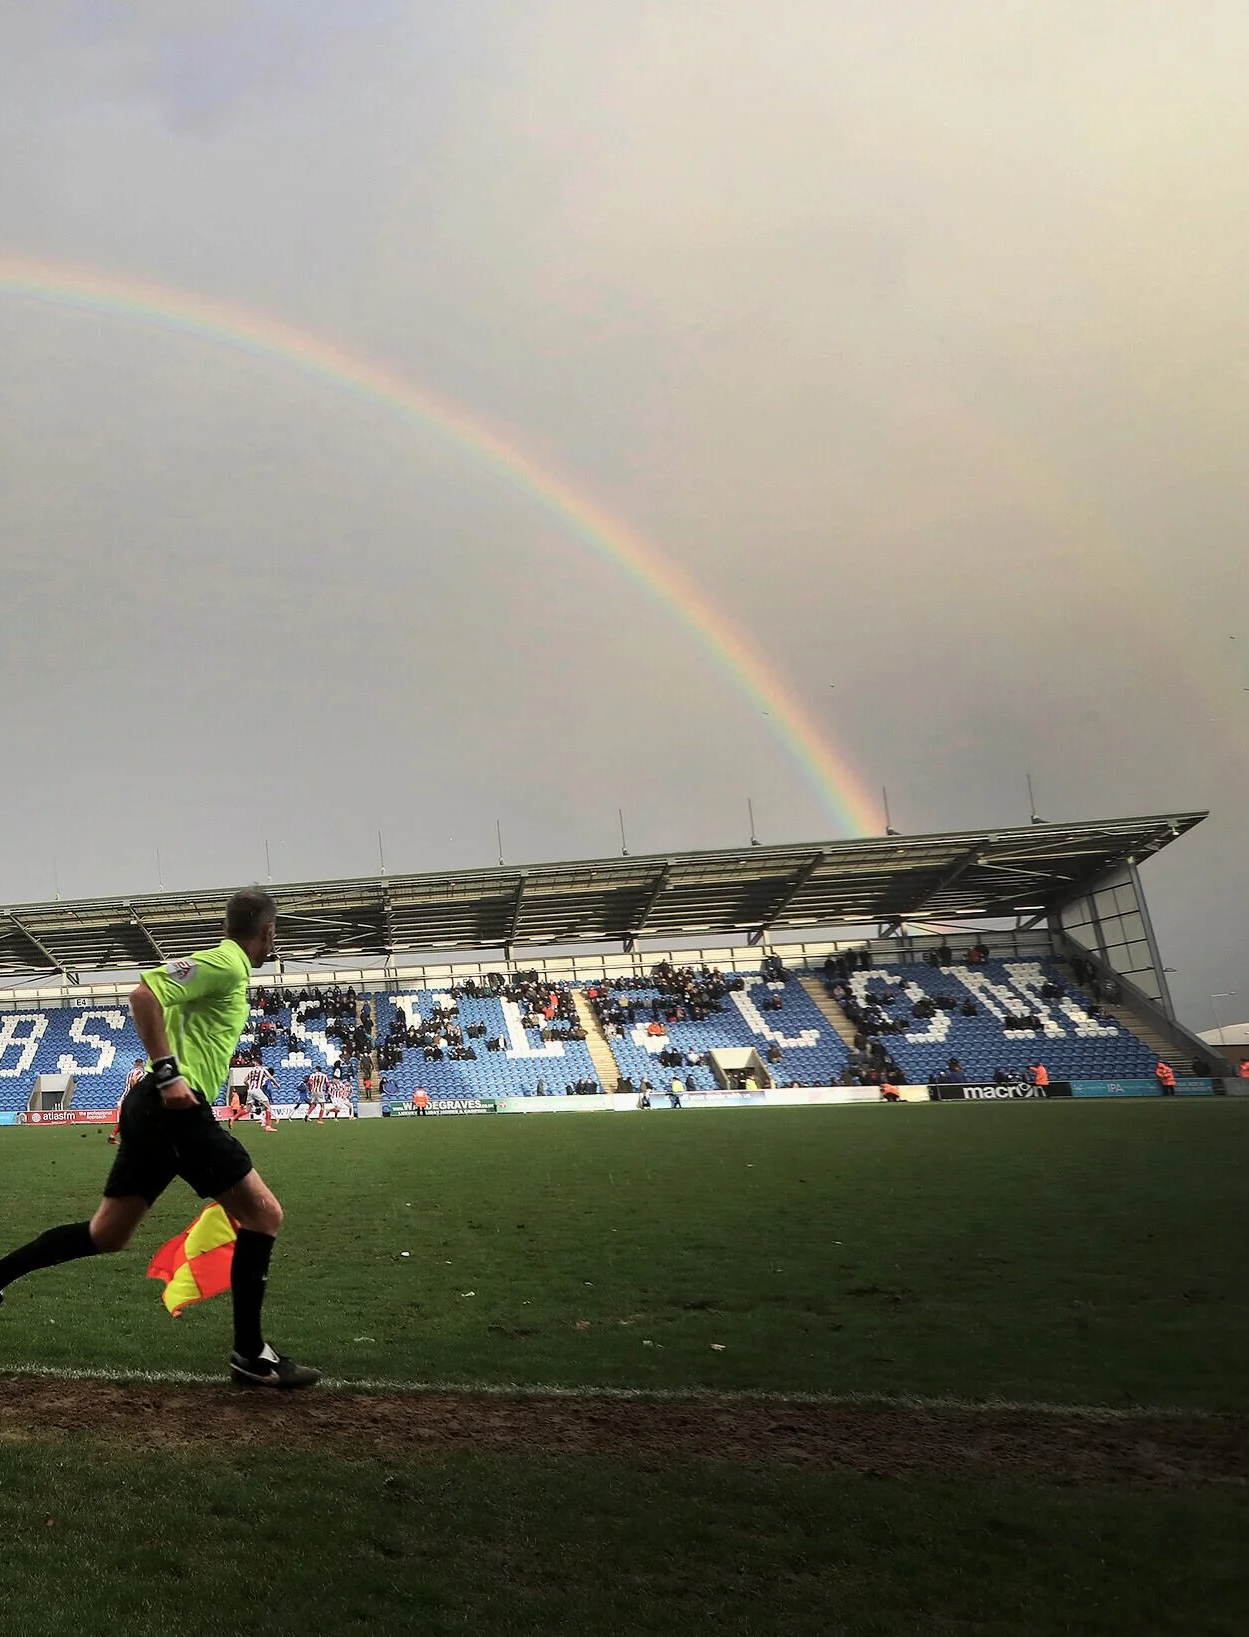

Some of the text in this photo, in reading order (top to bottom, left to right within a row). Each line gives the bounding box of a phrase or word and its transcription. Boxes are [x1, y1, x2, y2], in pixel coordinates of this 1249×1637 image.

[962, 1083, 1047, 1099] macron
[1107, 1083, 1125, 1094] IPA
[43, 1111, 76, 1121] atlasfm
